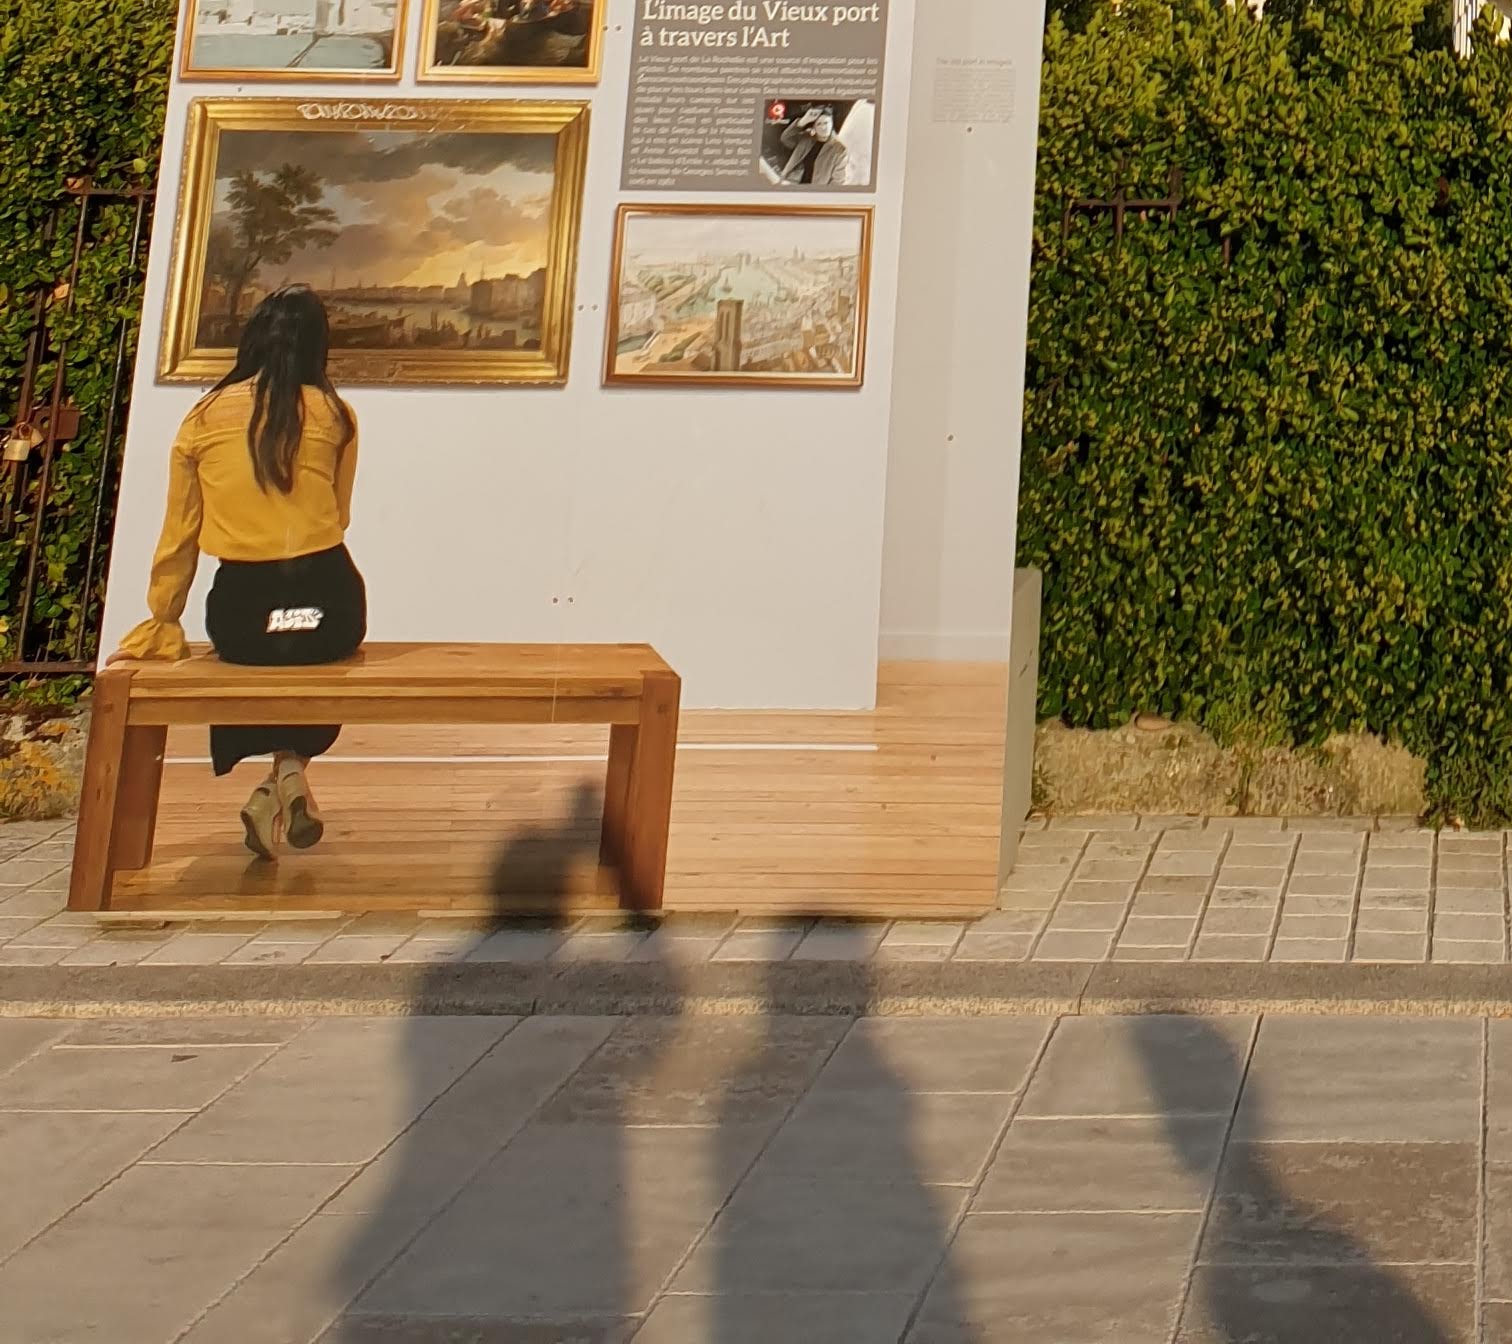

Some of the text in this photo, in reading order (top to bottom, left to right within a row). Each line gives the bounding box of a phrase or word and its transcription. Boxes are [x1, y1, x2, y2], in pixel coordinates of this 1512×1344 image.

[644, 0, 880, 25] L'image du Vieux port
[640, 26, 791, 47] à travers l'Art
